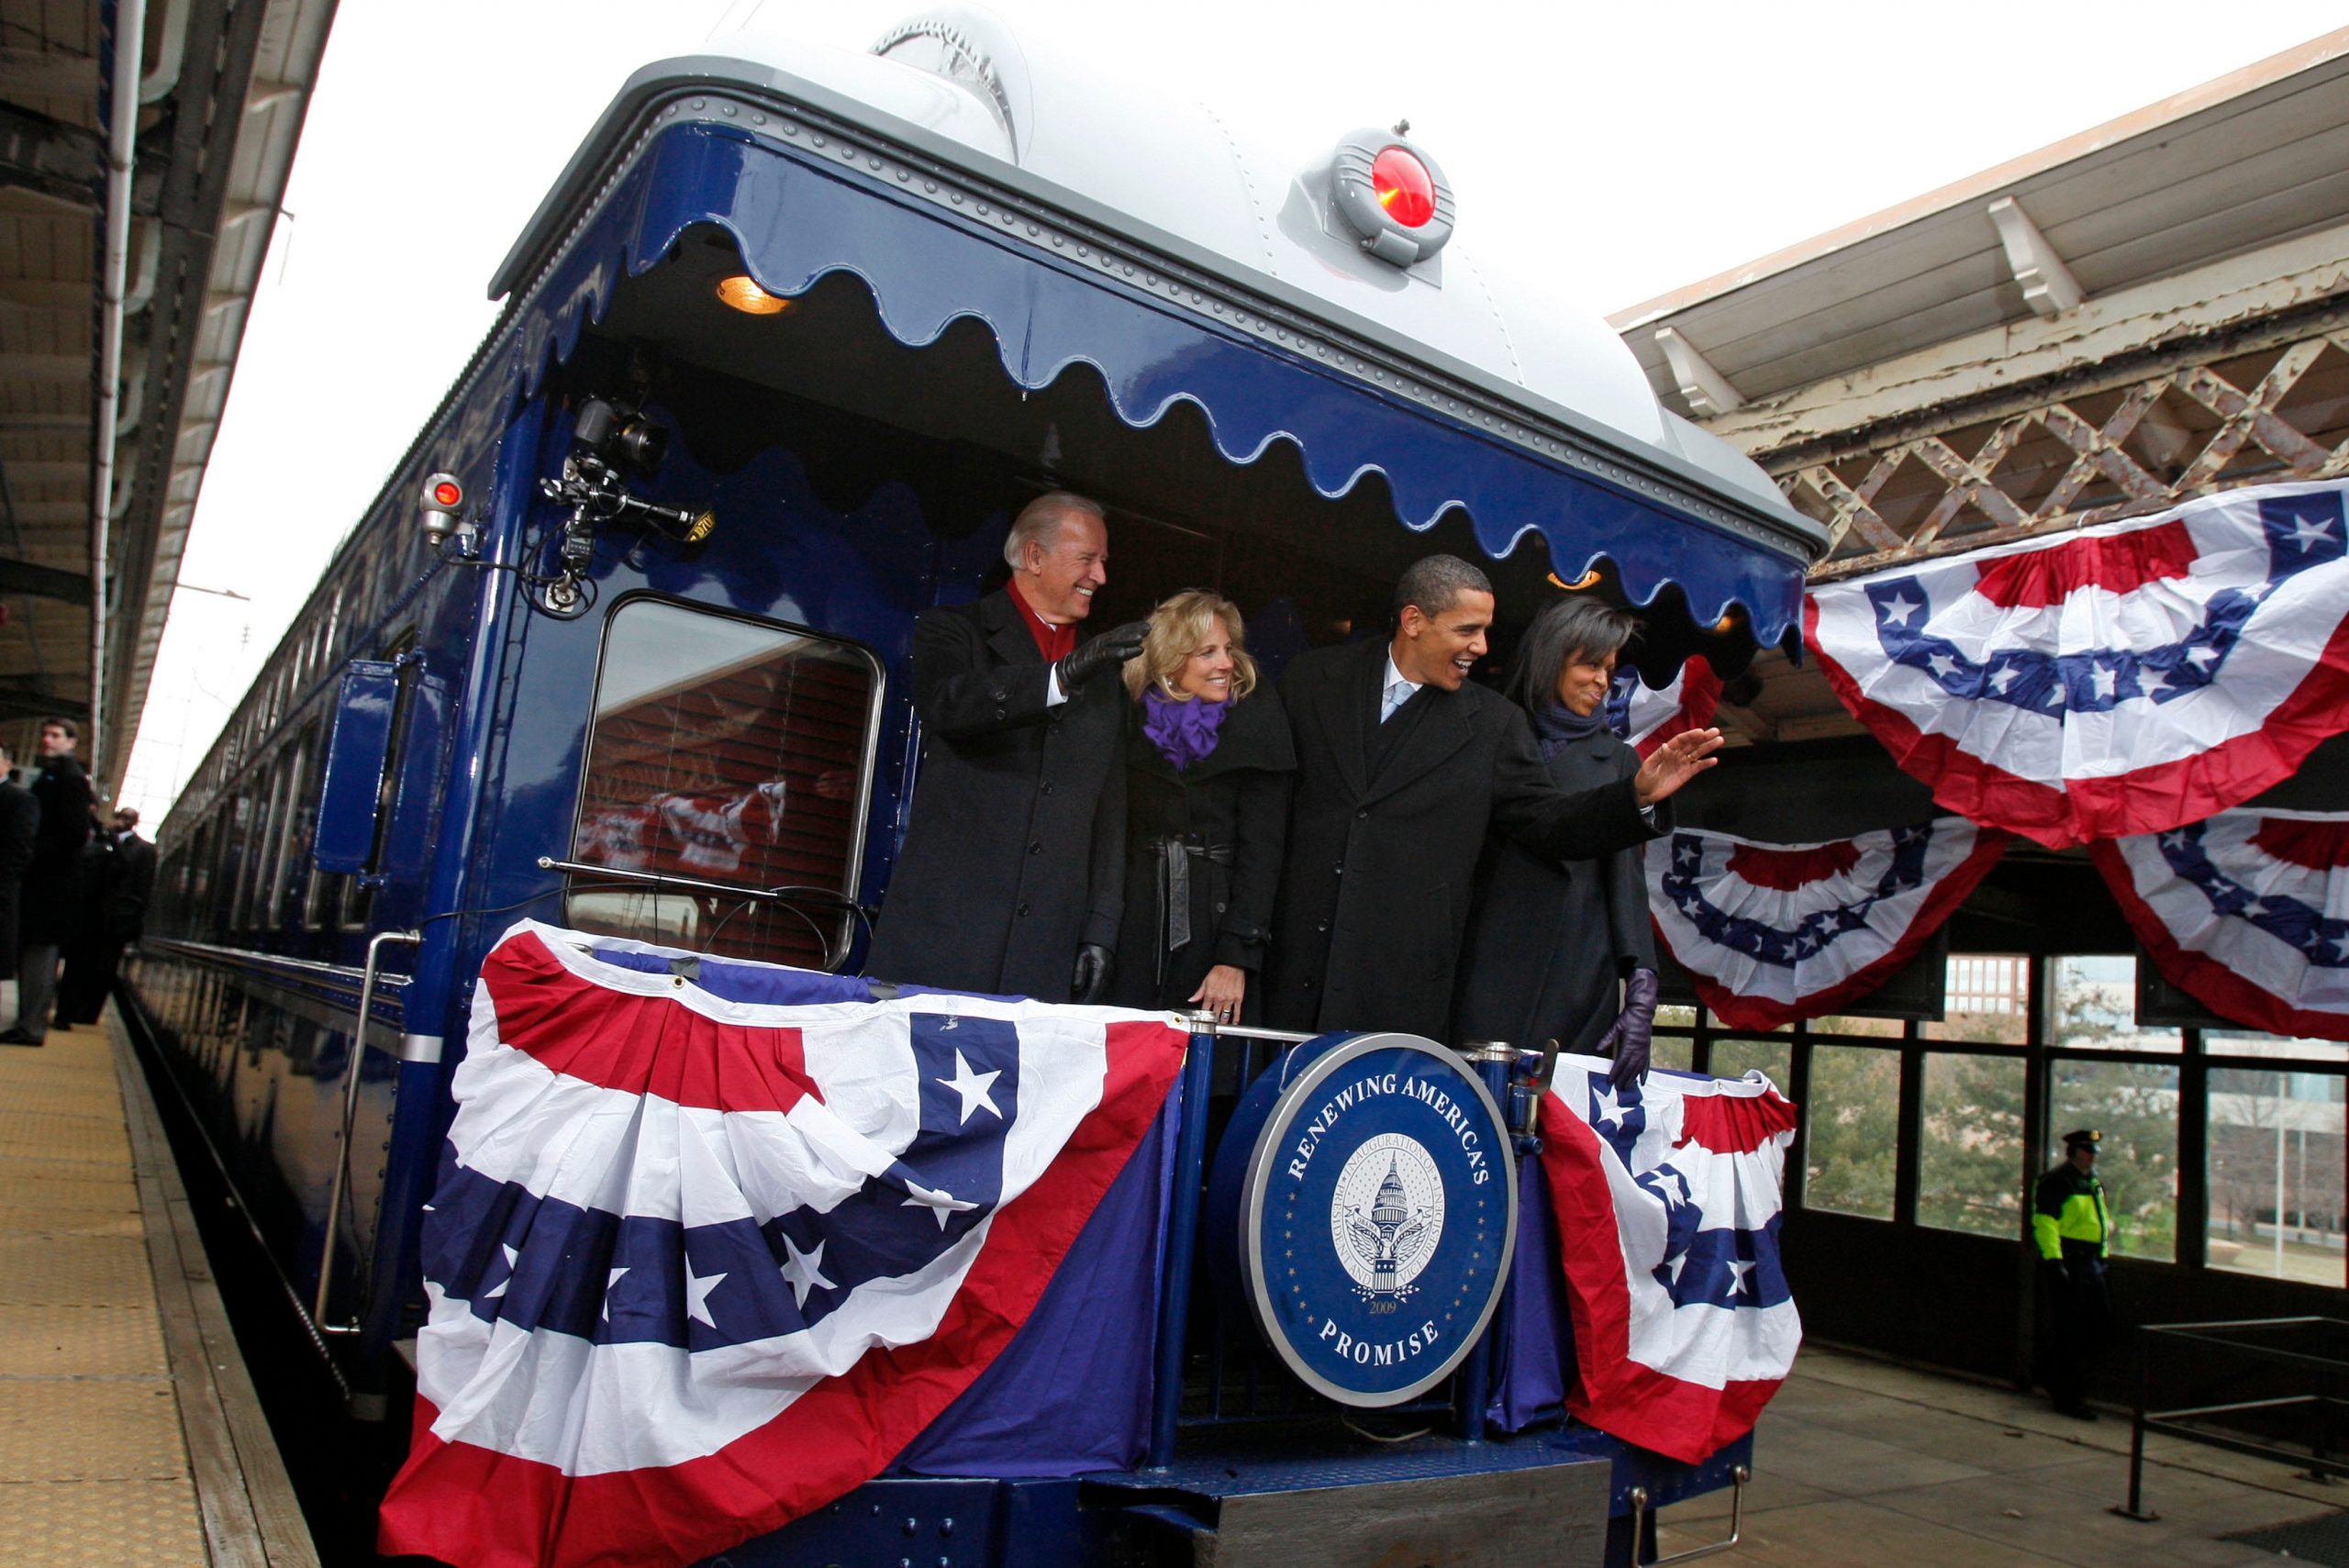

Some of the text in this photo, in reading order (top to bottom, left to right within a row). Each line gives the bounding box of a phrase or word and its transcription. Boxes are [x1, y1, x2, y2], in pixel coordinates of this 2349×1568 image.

[1287, 1073, 1489, 1185] RENEWING AMERICA'S
[1344, 1134, 1436, 1176] INAUGURATION OF
[1331, 1184, 1372, 1285] PRESIDENT AND
[1357, 1217, 1377, 1233] OBAMA
[1398, 1217, 1418, 1233] BIDEN
[1399, 1185, 1444, 1284] VICE PRESIDENT
[1369, 1301, 1397, 1315] 2009
[1319, 1318, 1439, 1366] PROMISE
